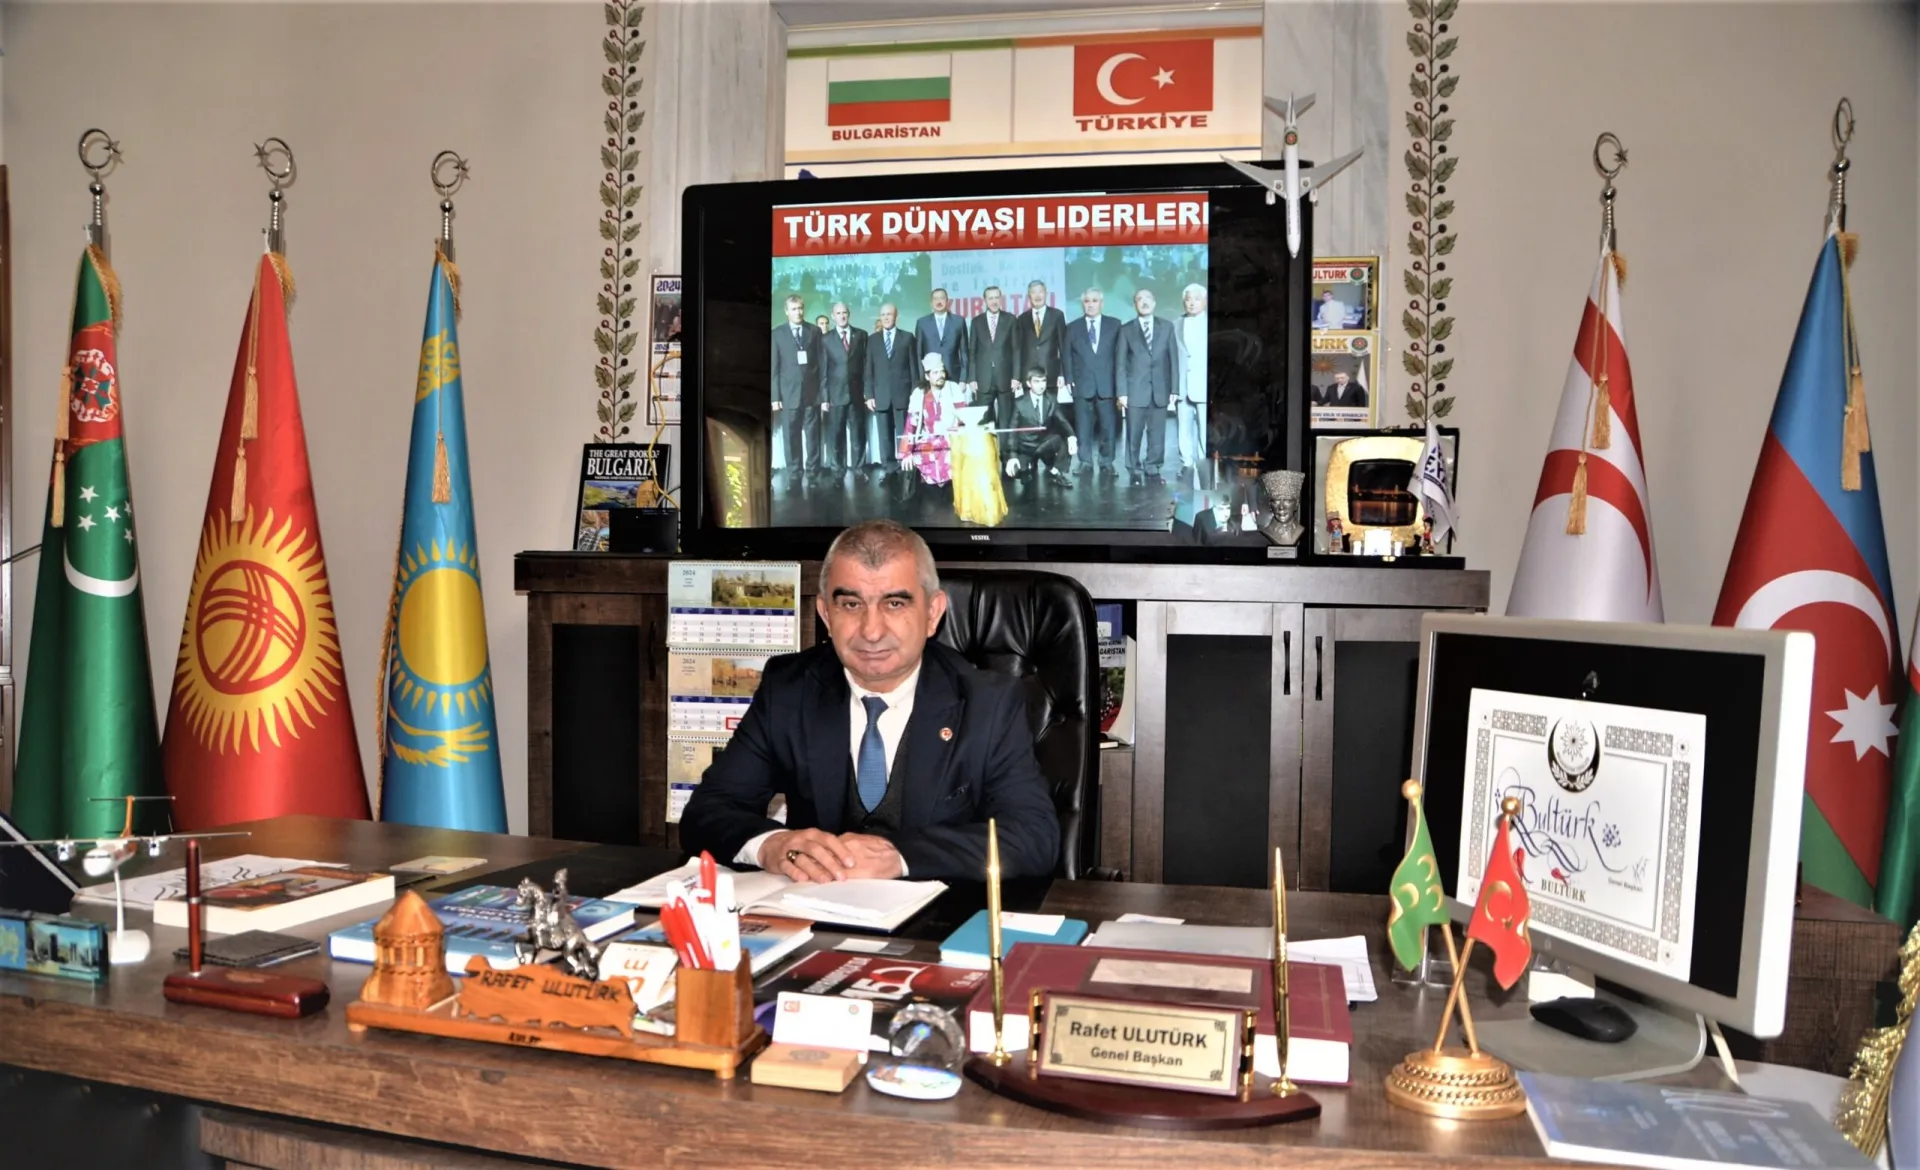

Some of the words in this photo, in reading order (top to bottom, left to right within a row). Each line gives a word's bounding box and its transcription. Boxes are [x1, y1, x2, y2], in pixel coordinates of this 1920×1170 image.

[1076, 112, 1208, 132] TÜRKİYE
[831, 125, 941, 141] BULGARİSTAN
[784, 211, 872, 239] TÜRK
[882, 207, 1025, 235] DÜNYASI
[589, 450, 603, 458] THE
[604, 450, 627, 458] GREAT
[628, 450, 650, 458] BOOK
[587, 458, 658, 476] BULGARIA
[480, 970, 534, 990] RAFET
[1069, 1021, 1117, 1041] Rafet
[1123, 1026, 1208, 1049] ULUTÜRK
[1090, 1046, 1129, 1062] Genel
[1132, 1050, 1184, 1068] Başkan
